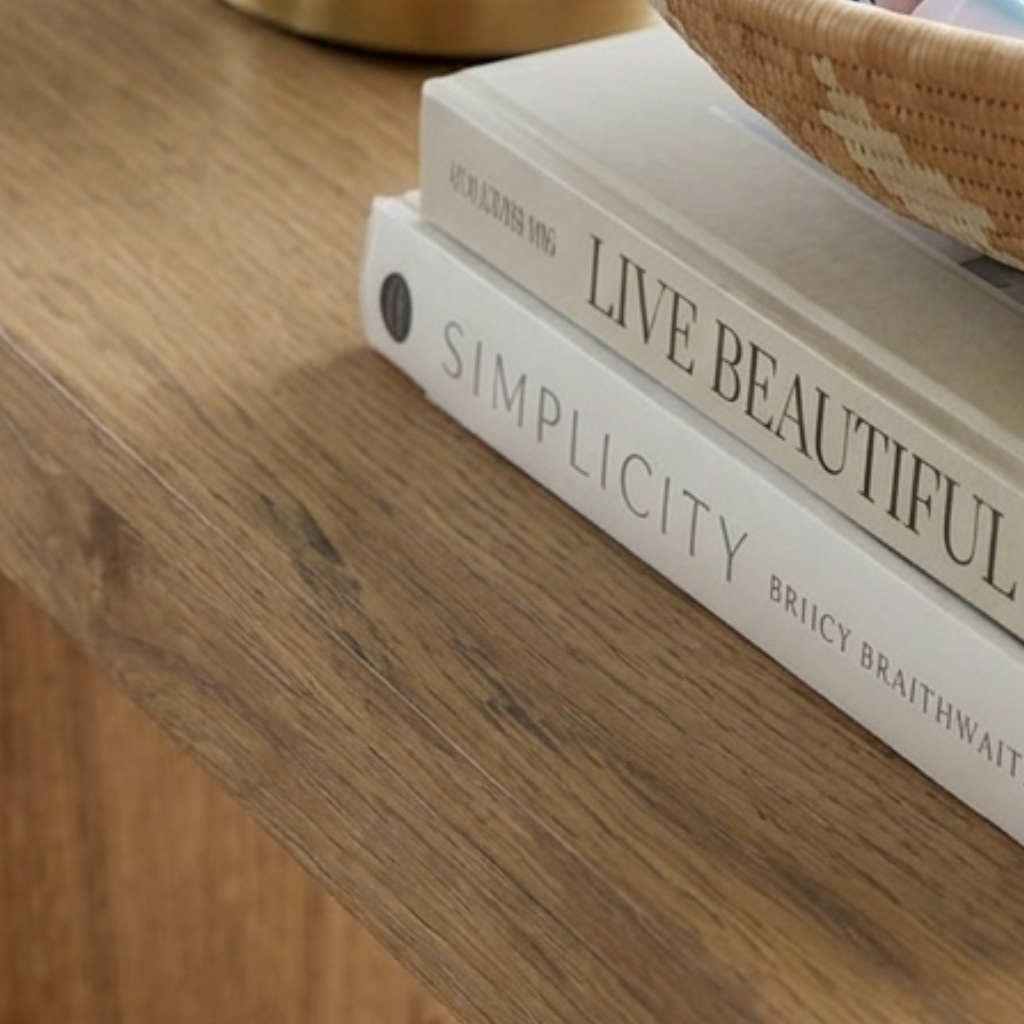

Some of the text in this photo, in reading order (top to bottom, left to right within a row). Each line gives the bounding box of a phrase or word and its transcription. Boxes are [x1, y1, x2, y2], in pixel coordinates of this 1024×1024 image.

[441, 320, 749, 583] SIMPLICITY
[586, 233, 1018, 603] LIVE BEAUTIFUL
